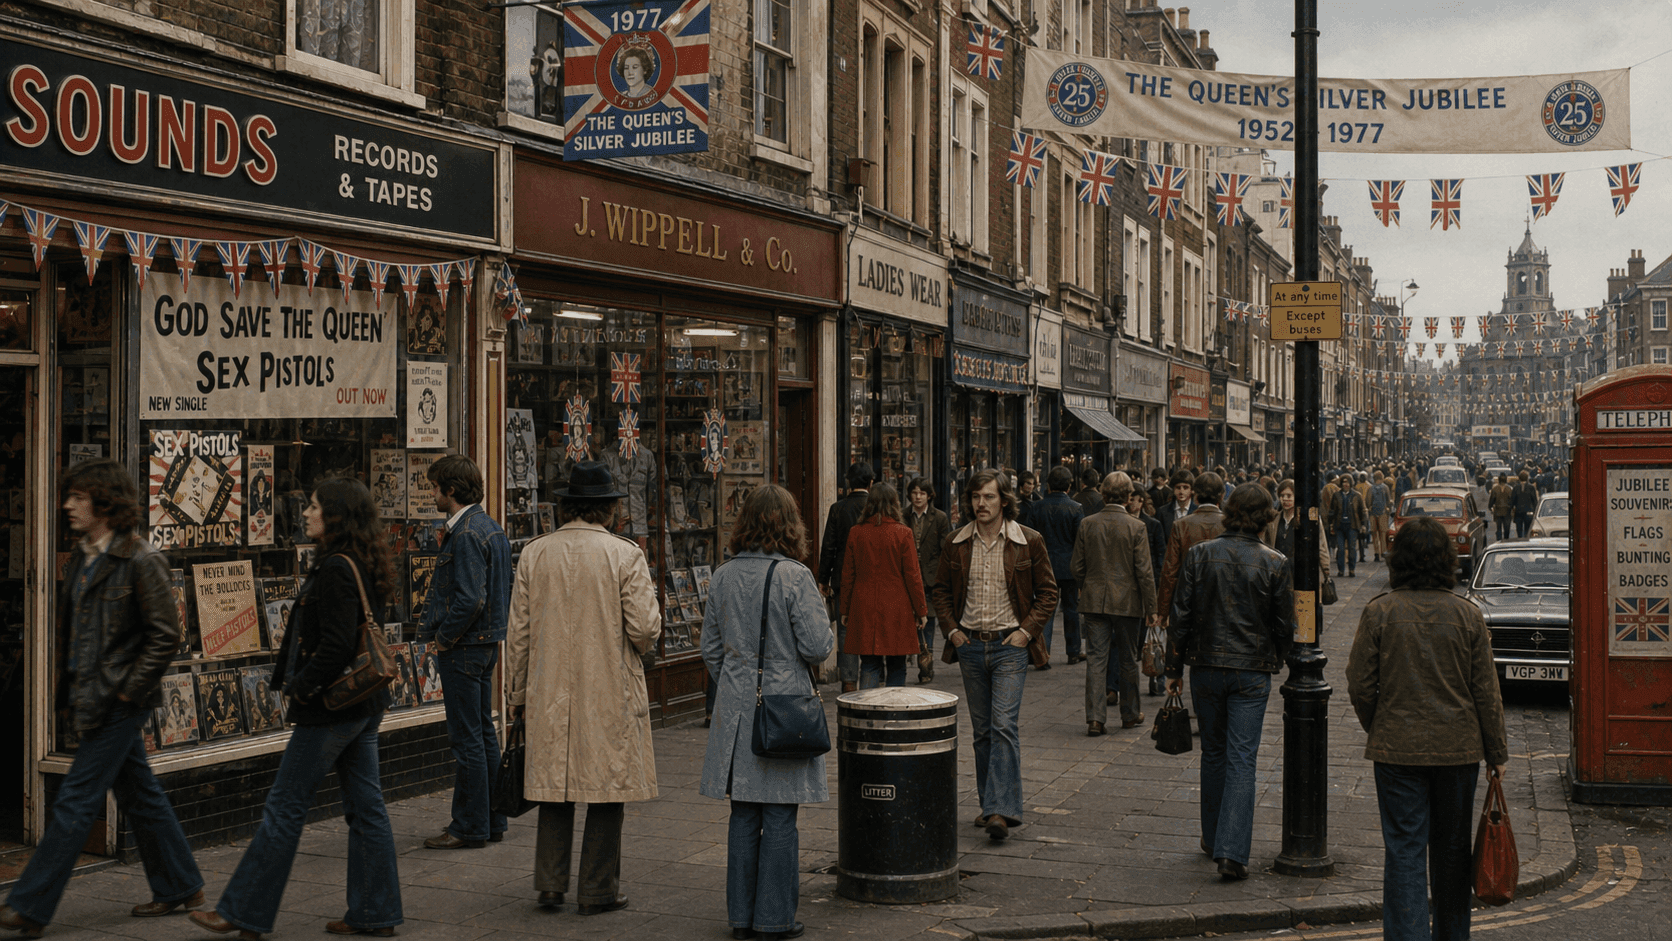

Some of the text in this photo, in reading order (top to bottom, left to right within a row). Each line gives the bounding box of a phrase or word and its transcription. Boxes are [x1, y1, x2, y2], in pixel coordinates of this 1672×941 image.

[610, 8, 662, 32] 1977
[1062, 82, 1091, 107] 25
[1125, 71, 1173, 98] THE
[1188, 79, 1290, 108] QUEEN'S
[1319, 88, 1388, 110] ILVER
[1401, 86, 1507, 110] JUBILEE
[5, 64, 278, 186] SOUNDS
[587, 110, 684, 132] THE QUEEN'S
[1559, 100, 1587, 126] 25
[574, 128, 696, 152] SILVER JUBILEE
[1237, 118, 1385, 143] 1952 1977
[334, 134, 438, 178] RECORDS
[338, 172, 433, 212] & TAPES
[574, 196, 596, 237] J.
[603, 201, 728, 261] WIPPELL
[741, 237, 755, 267] &
[858, 254, 942, 308] LADIES WEAR
[1275, 291, 1338, 304] At any time
[154, 294, 209, 337] GOD
[220, 301, 271, 339] SAVE
[280, 306, 313, 339] THE
[1286, 311, 1325, 323] Except
[1290, 324, 1322, 334] buses
[196, 350, 335, 394] SEX PISTOLS
[148, 395, 208, 412] NEW SINGLE
[336, 387, 387, 405] OUT NOW
[153, 431, 184, 458] SEX
[1616, 478, 1670, 492] JUBILEE
[185, 522, 236, 548] PISTOLS
[1623, 526, 1664, 540] FLAGS
[1617, 551, 1671, 565] BUNTING
[202, 565, 245, 579] NEVER MIND
[1619, 574, 1669, 588] BADGES
[200, 583, 214, 596] THE
[1511, 666, 1536, 679] VGP
[865, 788, 892, 797] LITTER
